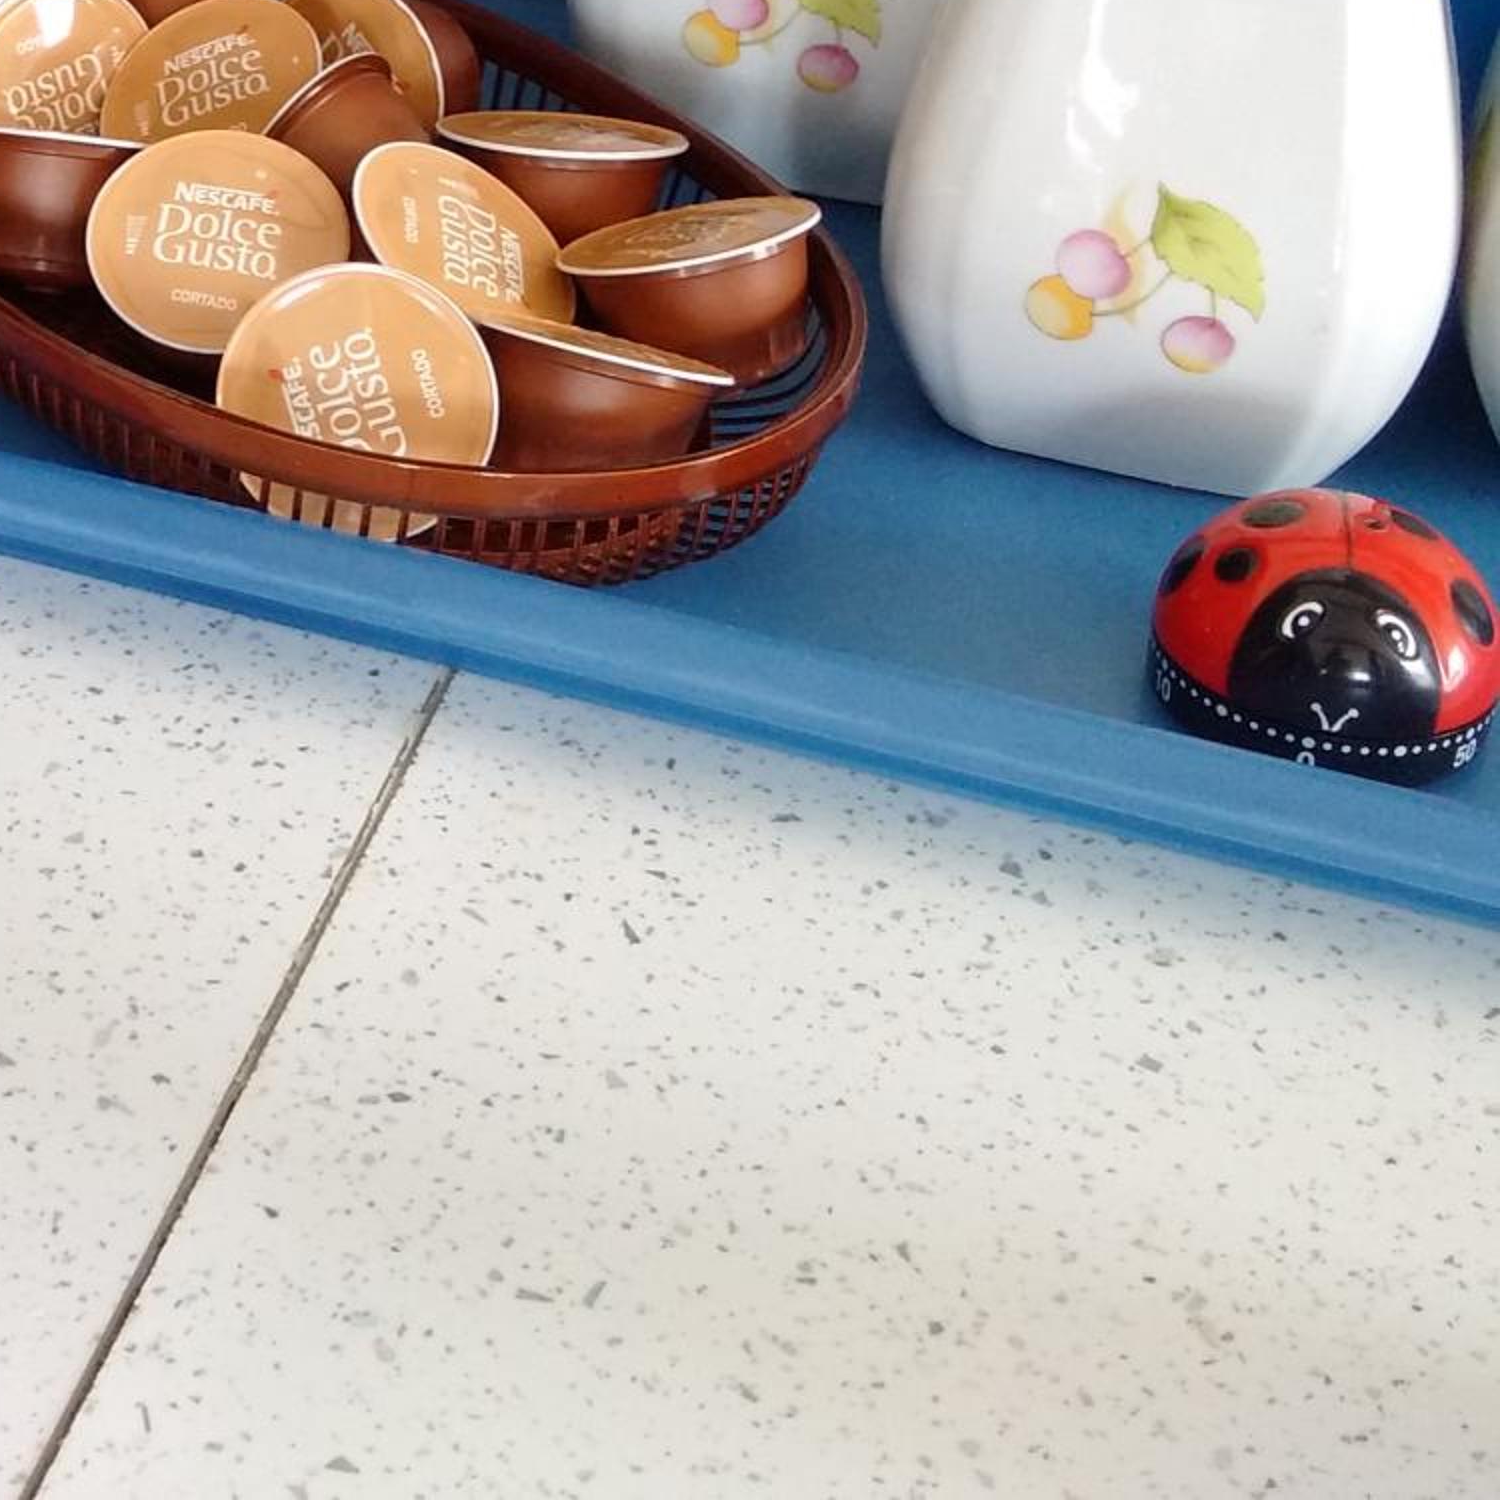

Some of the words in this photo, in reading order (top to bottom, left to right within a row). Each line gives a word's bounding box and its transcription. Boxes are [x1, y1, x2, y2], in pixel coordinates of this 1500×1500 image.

[16, 76, 105, 133] Dolc
[154, 48, 263, 108] Dolce
[161, 72, 271, 127] Gusto
[159, 202, 283, 250] Dolce
[437, 194, 471, 287] Gusto
[465, 203, 501, 299] Dolce
[152, 231, 277, 281] Gusto
[170, 287, 239, 312] CORTADO
[309, 341, 372, 451] olce
